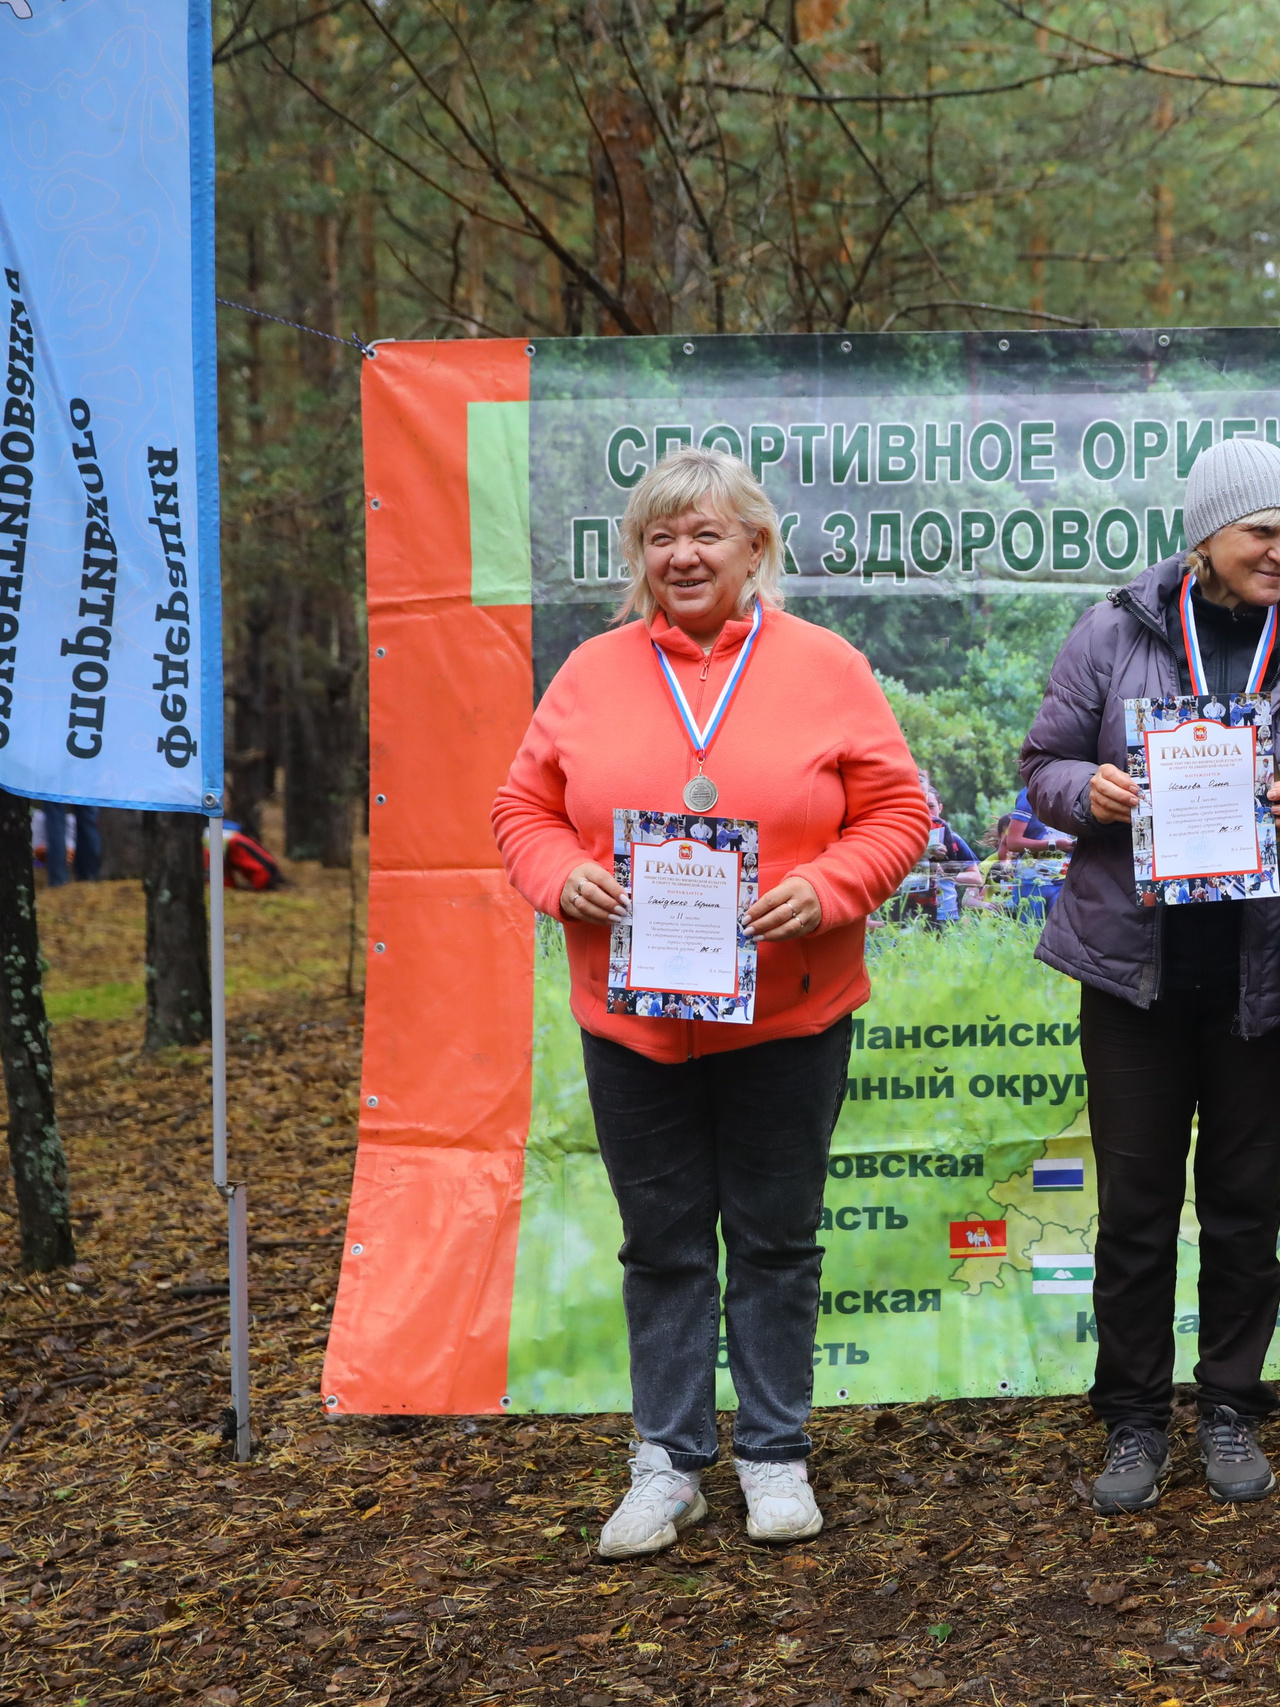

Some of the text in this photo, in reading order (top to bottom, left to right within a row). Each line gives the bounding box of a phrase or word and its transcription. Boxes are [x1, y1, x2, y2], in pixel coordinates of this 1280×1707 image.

[820, 507, 1190, 585] ЗДОРОВОМ
[1160, 742, 1241, 759] ГРАМОТА
[644, 859, 726, 878] ГРАМОТА
[968, 1072, 1089, 1106] округ
